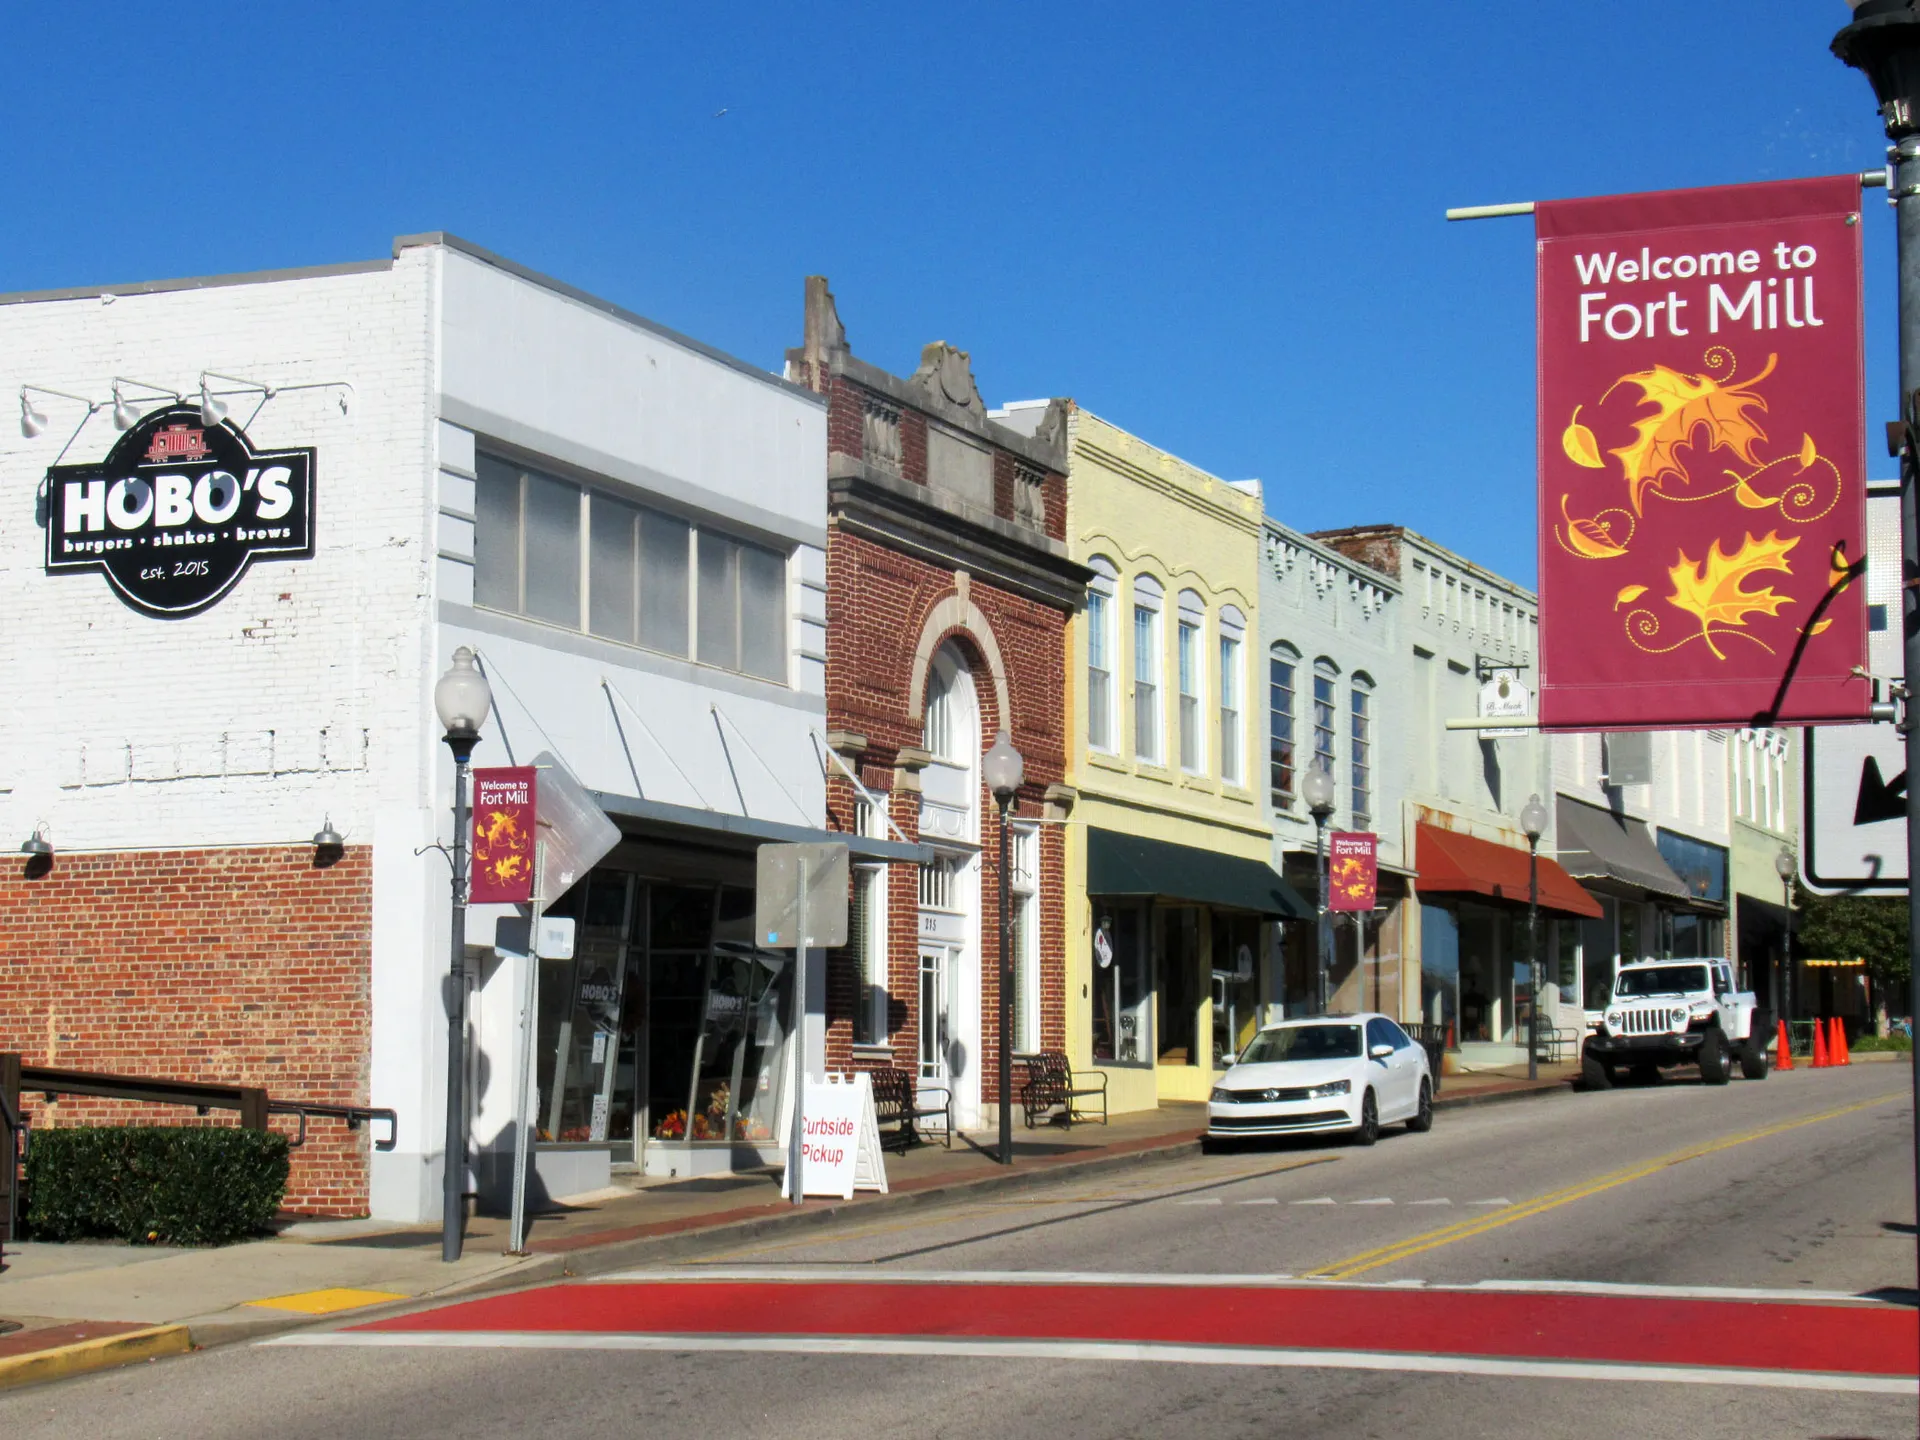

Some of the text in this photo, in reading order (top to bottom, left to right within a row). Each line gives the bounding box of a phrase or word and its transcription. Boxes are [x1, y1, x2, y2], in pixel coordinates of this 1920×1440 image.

[1574, 241, 1817, 285] Welcome to
[1579, 276, 1825, 342] Fort Mill
[63, 466, 294, 534] HOBO'S
[63, 526, 291, 554] burgers shakes brews
[140, 560, 209, 580] est. 2015
[480, 781, 528, 790] Welcome to
[480, 790, 529, 805] Fort Mill
[1336, 846, 1371, 855] Fort Mill
[581, 983, 618, 1001] HOBO'S
